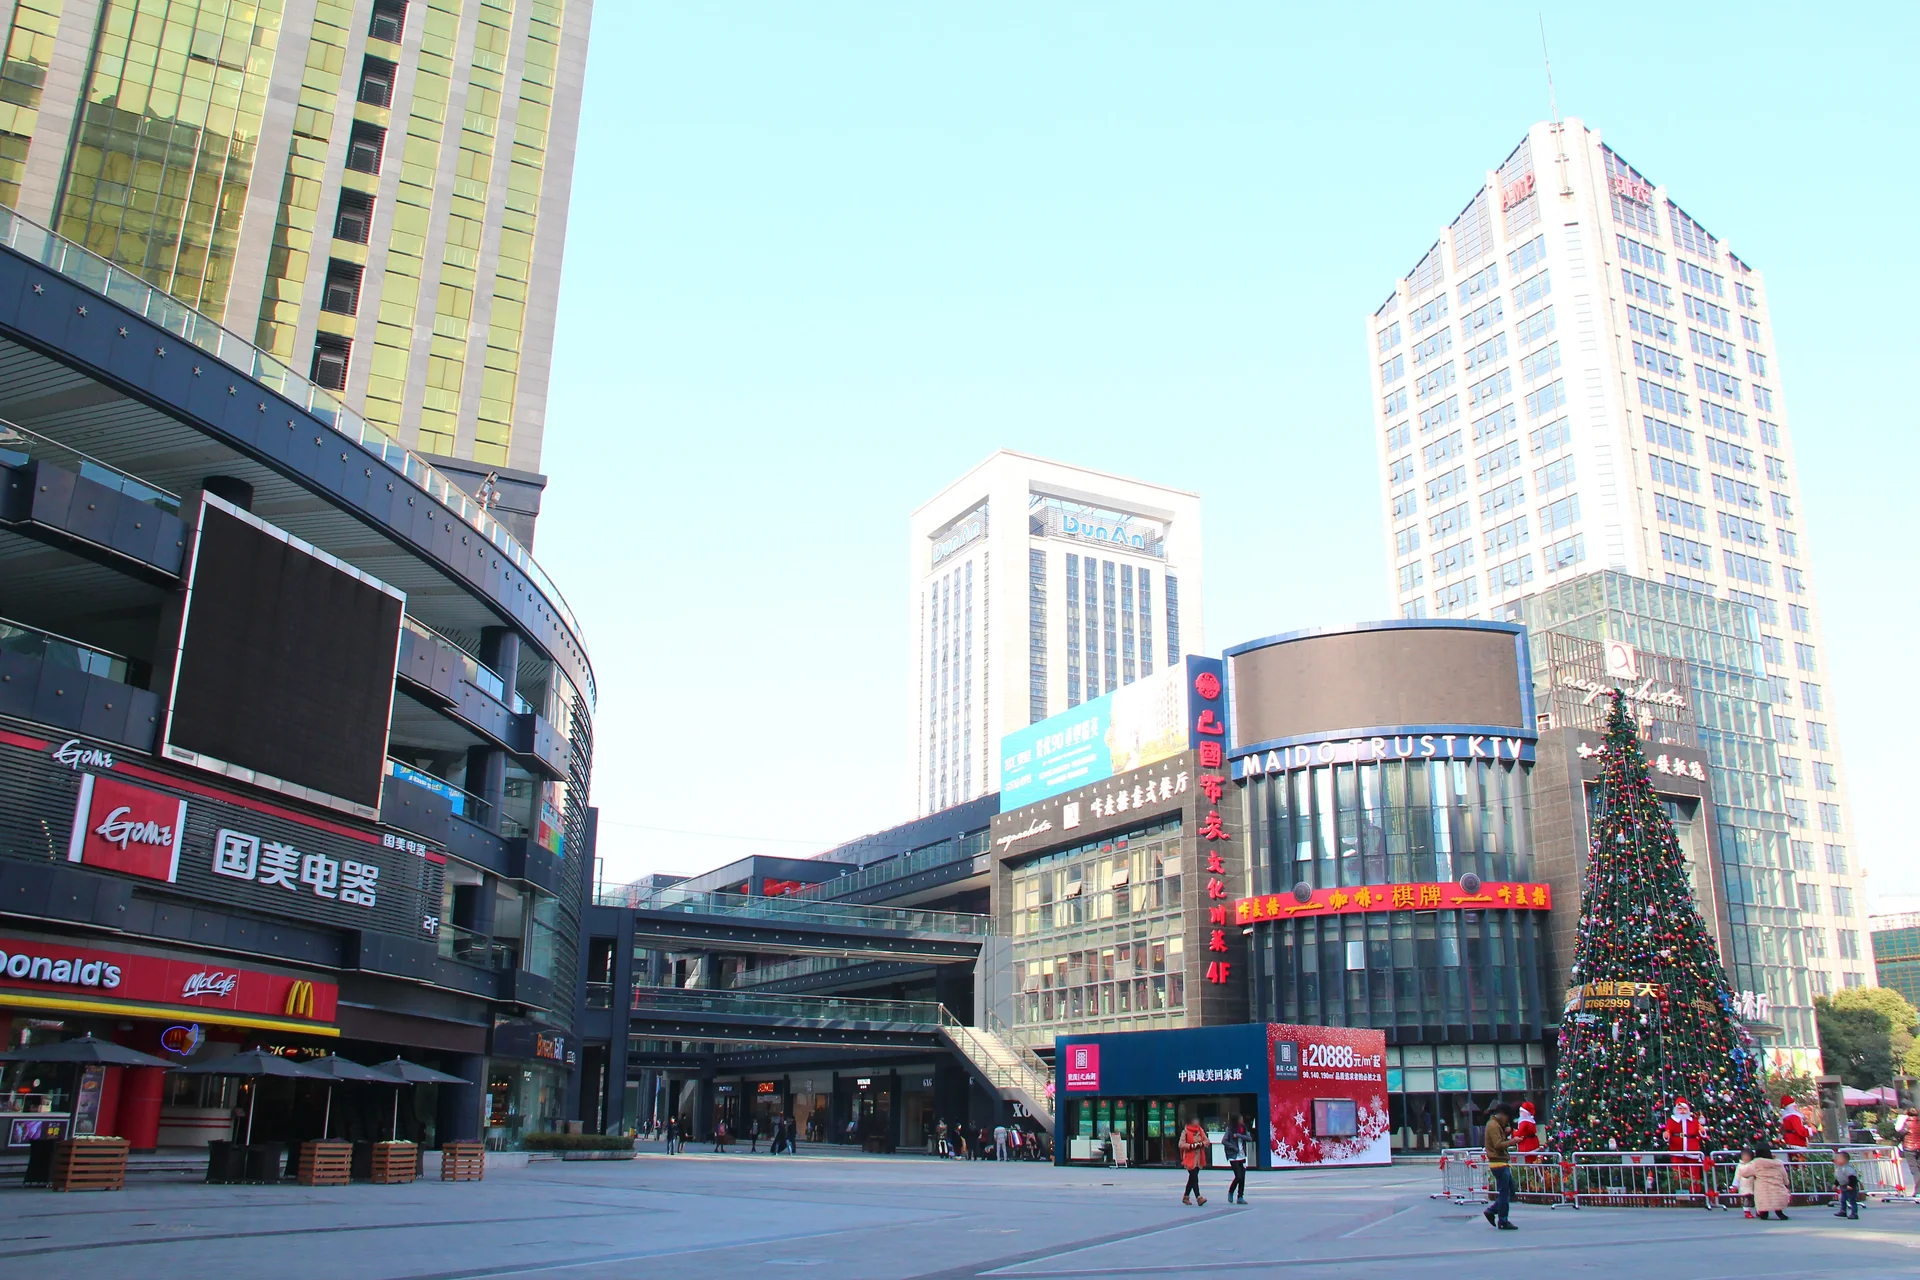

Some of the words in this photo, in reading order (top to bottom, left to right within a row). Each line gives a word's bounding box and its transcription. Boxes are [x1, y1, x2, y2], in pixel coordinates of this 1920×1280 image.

[933, 521, 980, 563] DunAn
[1062, 515, 1145, 549] DunAn
[1242, 742, 1336, 776] MAIDO
[1349, 735, 1456, 760] TRUST
[1468, 736, 1523, 760] KTV
[383, 833, 426, 858] 国美电器
[212, 828, 380, 907] 国美电器
[423, 915, 438, 934] 2F
[182, 972, 237, 997] McCafé
[1206, 961, 1231, 984] 4F
[1178, 1068, 1243, 1083] 中国最美回家路
